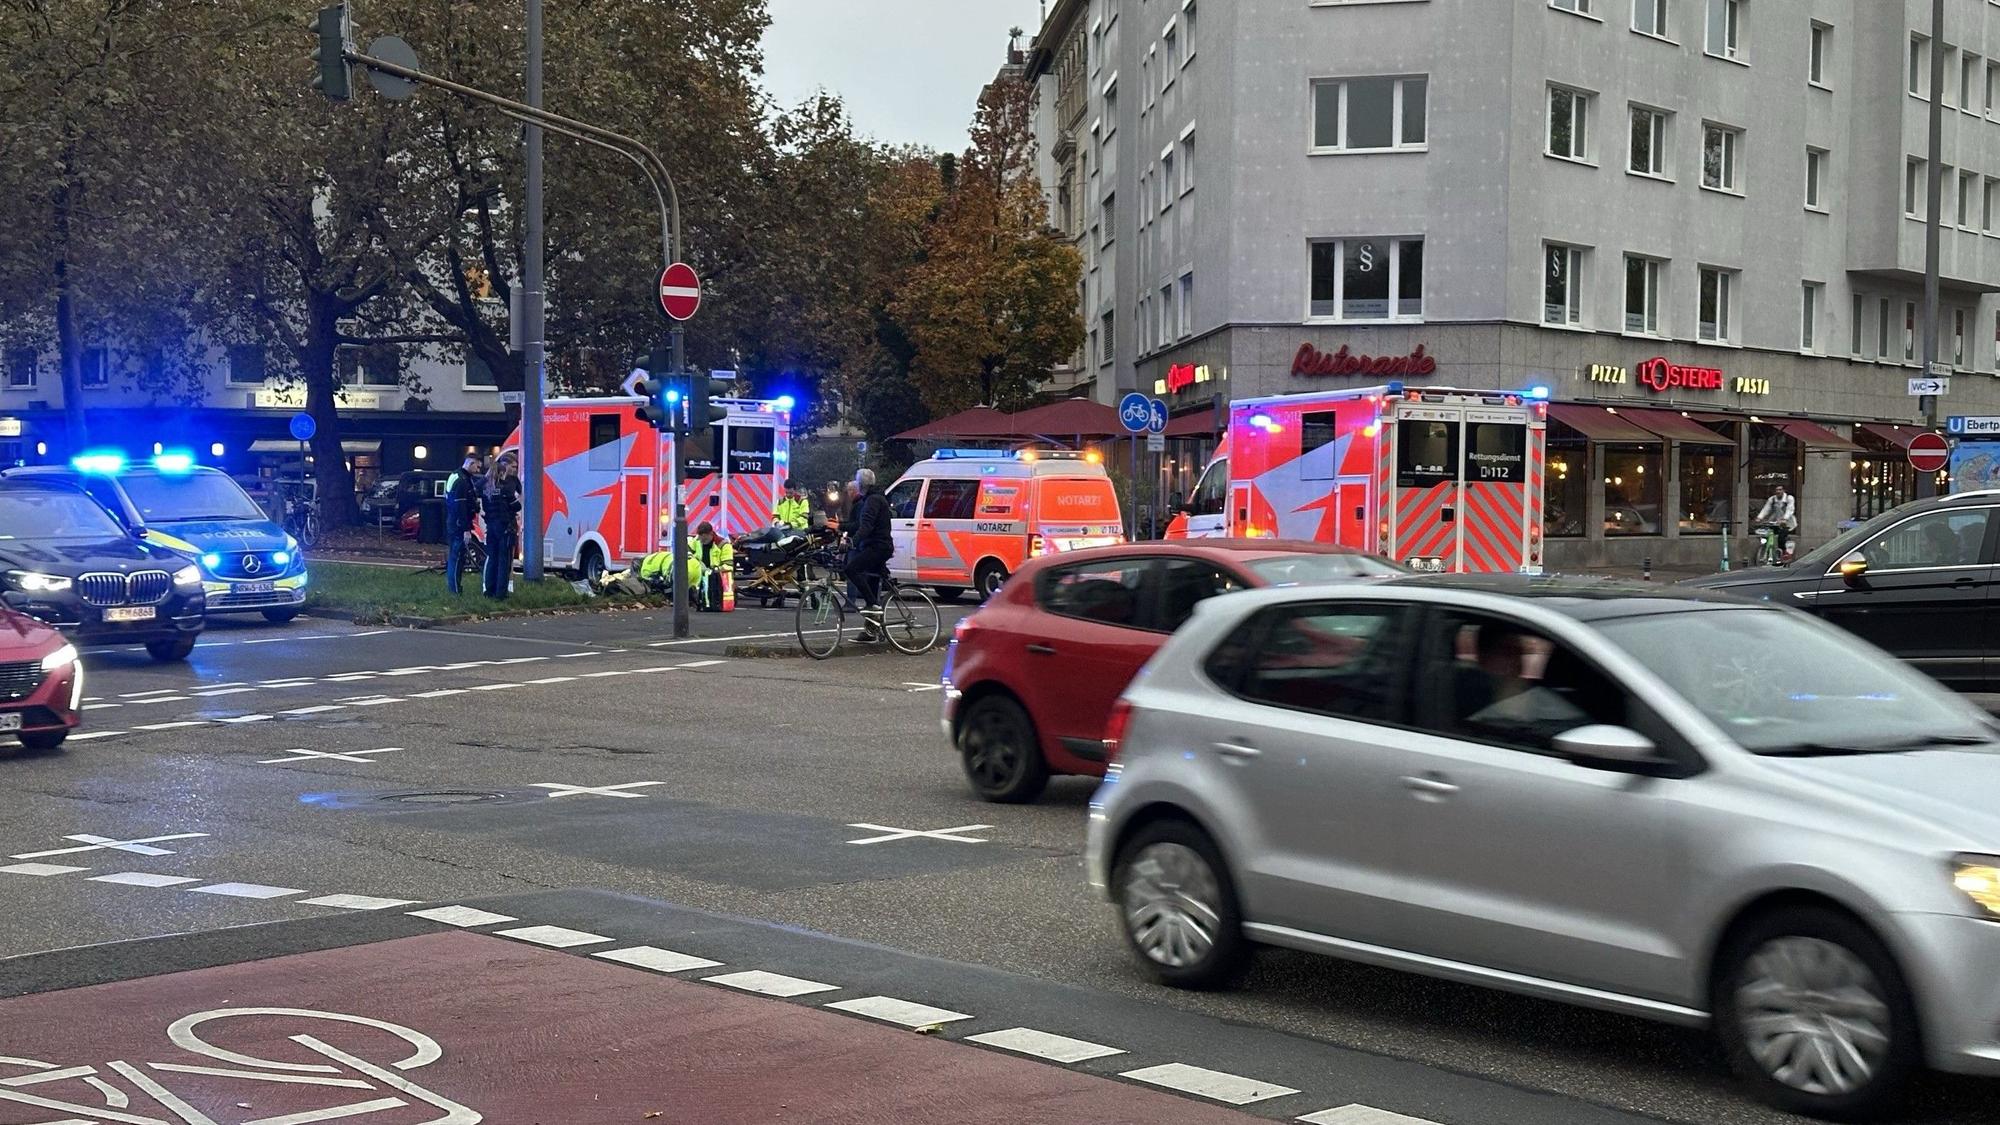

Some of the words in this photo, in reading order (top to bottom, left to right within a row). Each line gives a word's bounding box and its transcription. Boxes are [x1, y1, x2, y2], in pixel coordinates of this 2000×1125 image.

[1291, 343, 1437, 377] Ristorante
[1591, 364, 1627, 384] PIZZA
[1736, 377, 1770, 395] PASTA
[1911, 382, 1927, 391] WC
[1950, 418, 1962, 432] U
[1967, 420, 2000, 431] Ebertp
[1469, 452, 1521, 462] Rettungsdienst
[748, 461, 762, 471] 112
[1491, 466, 1509, 478] 112
[1057, 495, 1102, 507] NOTARZT
[976, 522, 1013, 533] NOTARZT
[1108, 525, 1119, 534] 112
[201, 529, 266, 540] POLIZEI
